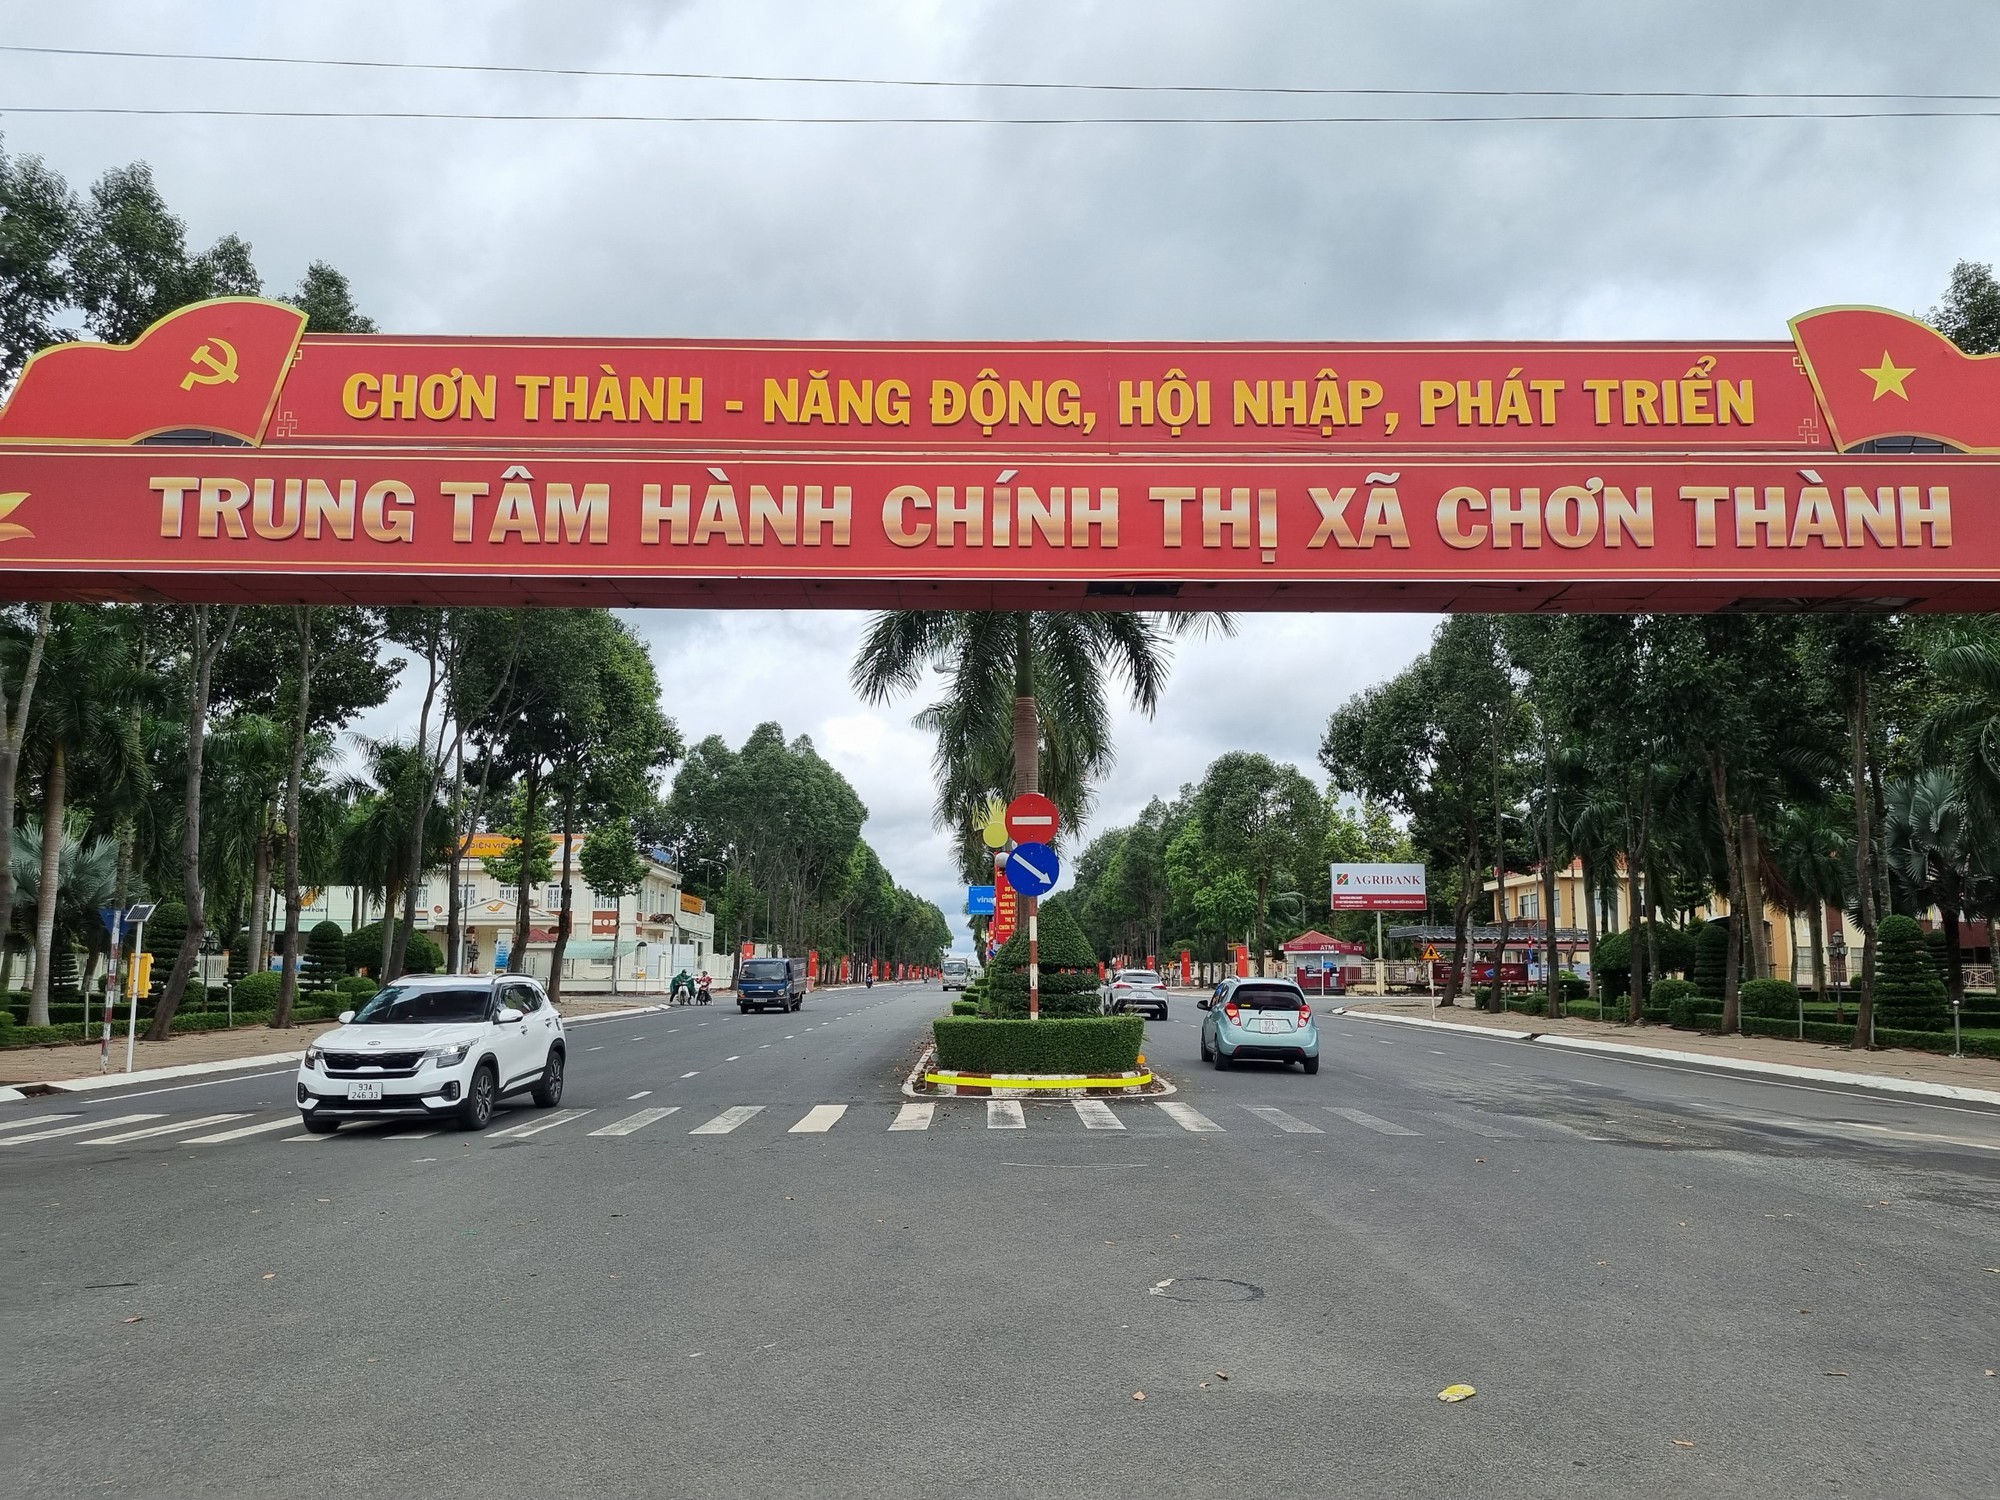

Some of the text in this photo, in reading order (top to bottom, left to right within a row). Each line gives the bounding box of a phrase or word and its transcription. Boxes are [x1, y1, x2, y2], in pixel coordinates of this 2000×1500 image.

[342, 367, 497, 421] CHƠN
[515, 365, 703, 423] THÀNH
[763, 370, 910, 425] NĂNG
[930, 368, 1096, 436] ĐỘNG,
[1119, 368, 1211, 436] HỘI
[1234, 368, 1399, 436] NHẬP,
[1420, 367, 1565, 425] PHÁT
[1582, 355, 1755, 425] TRIỂN
[149, 465, 1953, 562] TRUNG TÂM HÀNH CHÍNH THỊ XÃ CHƠN THÀNH
[1353, 875, 1421, 885] AGRIBANK
[358, 1083, 373, 1091] 93A
